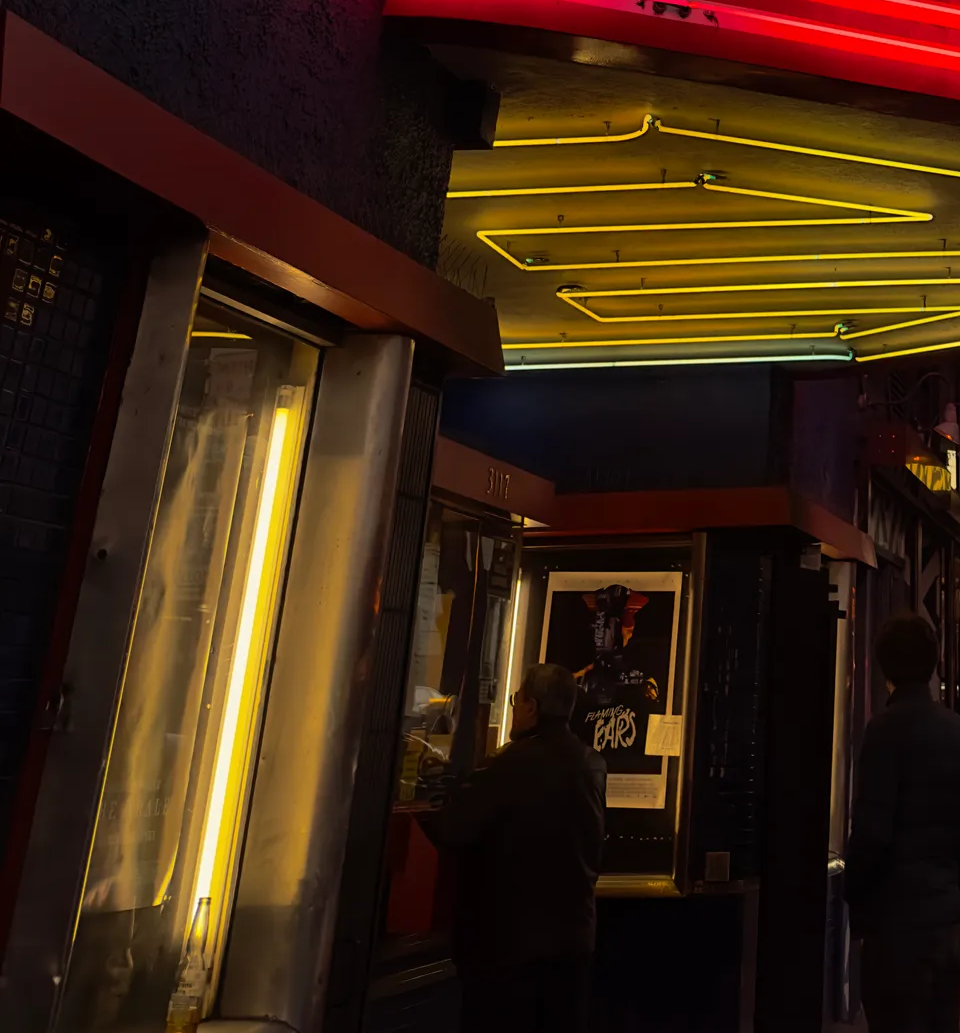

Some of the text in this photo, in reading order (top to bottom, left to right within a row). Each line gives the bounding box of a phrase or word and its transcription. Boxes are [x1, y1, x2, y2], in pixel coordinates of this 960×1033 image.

[486, 466, 512, 500] 3117
[585, 704, 624, 723] FLAMING
[593, 708, 637, 753] EARS
